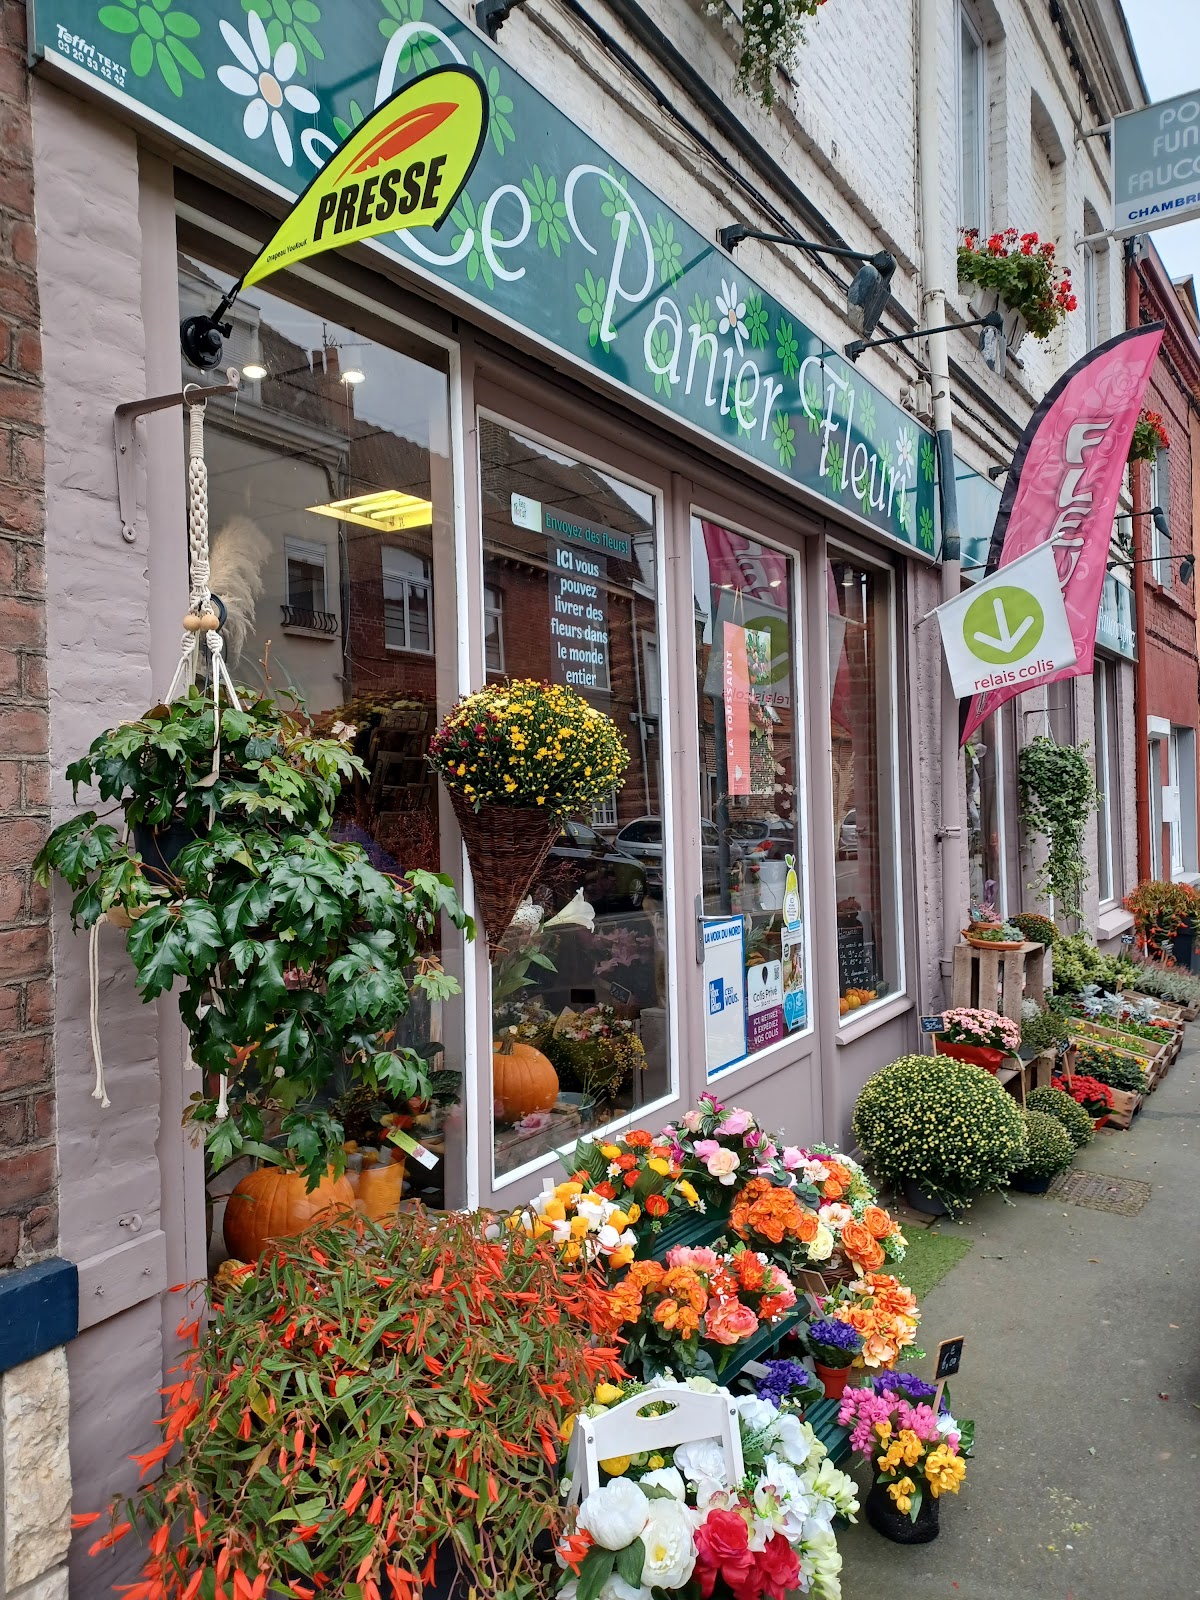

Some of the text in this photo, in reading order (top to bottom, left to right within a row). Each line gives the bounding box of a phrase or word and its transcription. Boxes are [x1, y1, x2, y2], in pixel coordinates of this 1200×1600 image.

[56, 23, 127, 77] Teffri TEXT
[57, 39, 125, 88] 03 20 53 42 42
[313, 154, 448, 242] PRESSE
[1128, 192, 1200, 220] CHAMBR
[564, 164, 784, 441] Panier
[799, 356, 907, 523] Fleuri
[545, 512, 628, 554] Envoyez des fleurs!
[556, 548, 599, 577] ICI vous
[560, 577, 597, 598] pouvez
[554, 594, 604, 621] livrer des
[551, 617, 608, 644] fleurs dans
[557, 641, 604, 665] le monde
[565, 668, 597, 686] entier
[974, 659, 1054, 690] relais colis
[726, 650, 734, 756] LA TOUSSAINT
[704, 925, 741, 944] LA VOIX DU NORD
[753, 986, 777, 1002] Colis Privé
[761, 1010, 778, 1023] RETIREZ
[754, 1028, 778, 1045] VOS COLIS
